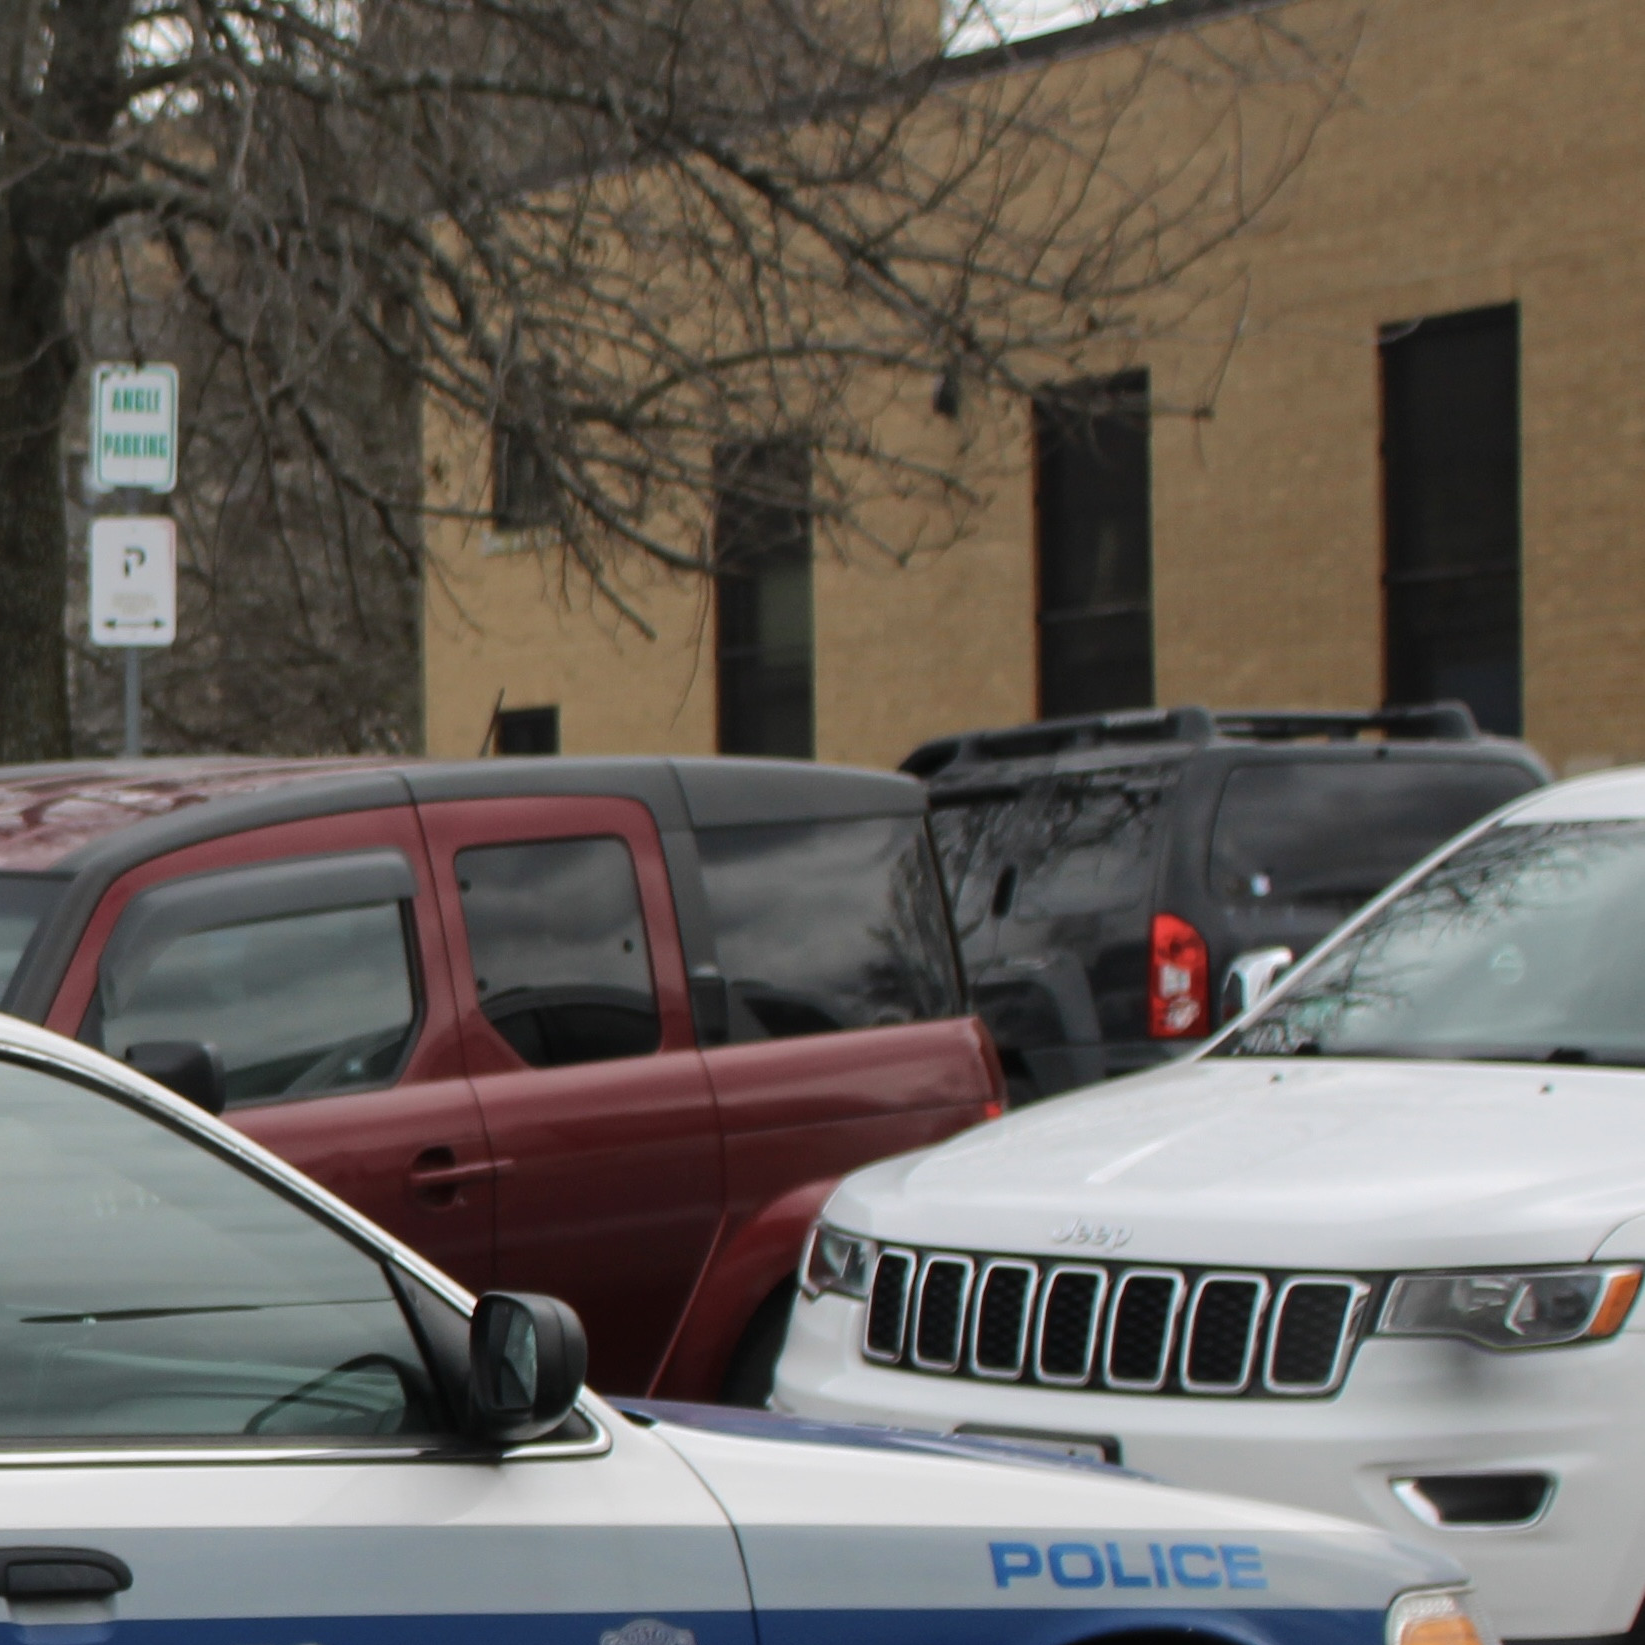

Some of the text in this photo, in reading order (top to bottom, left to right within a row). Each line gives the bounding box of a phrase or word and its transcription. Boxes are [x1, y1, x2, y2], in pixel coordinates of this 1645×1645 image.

[112, 387, 161, 413] ANGLE
[103, 432, 169, 458] PARKING
[1051, 1217, 1134, 1251] Jeep
[988, 1541, 1269, 1589] POLICE
